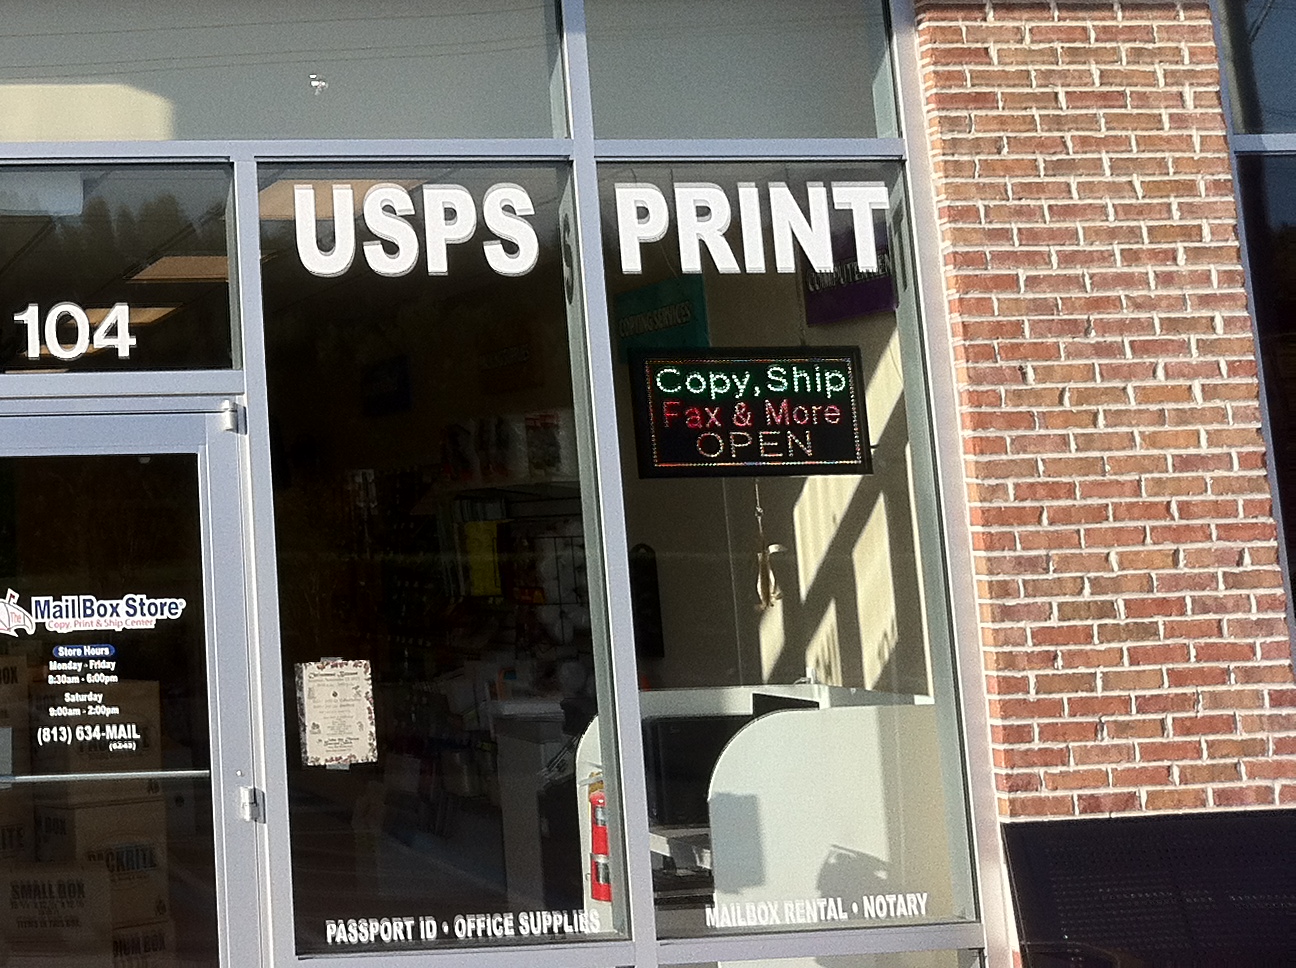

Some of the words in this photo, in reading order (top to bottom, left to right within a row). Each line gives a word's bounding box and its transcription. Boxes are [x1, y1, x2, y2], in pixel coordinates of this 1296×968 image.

[293, 183, 539, 279] USPS
[614, 181, 890, 274] PRINT
[13, 302, 138, 361] 104
[661, 401, 721, 429] Fax
[732, 401, 752, 427] &
[764, 399, 842, 426] More
[696, 431, 813, 458] OPEN
[34, 598, 76, 620] Mail
[82, 598, 120, 618] Box
[73, 620, 94, 628] Print
[104, 618, 124, 628] Ship
[124, 618, 154, 627] Center
[57, 646, 82, 657] Store
[83, 645, 110, 656] Hours
[48, 660, 83, 672] Monday
[88, 659, 117, 672] Friday
[64, 691, 103, 704] Saturday
[37, 724, 73, 747] (813)
[75, 723, 141, 742] 634-MAIL
[705, 901, 782, 928] MAILBOX
[783, 897, 848, 924] RENTAL
[862, 892, 928, 919] NOTARY
[324, 919, 415, 944] PASSPORT
[418, 916, 437, 941] ID
[454, 913, 515, 939] OFFICE
[519, 908, 601, 934] SUPPLIES
